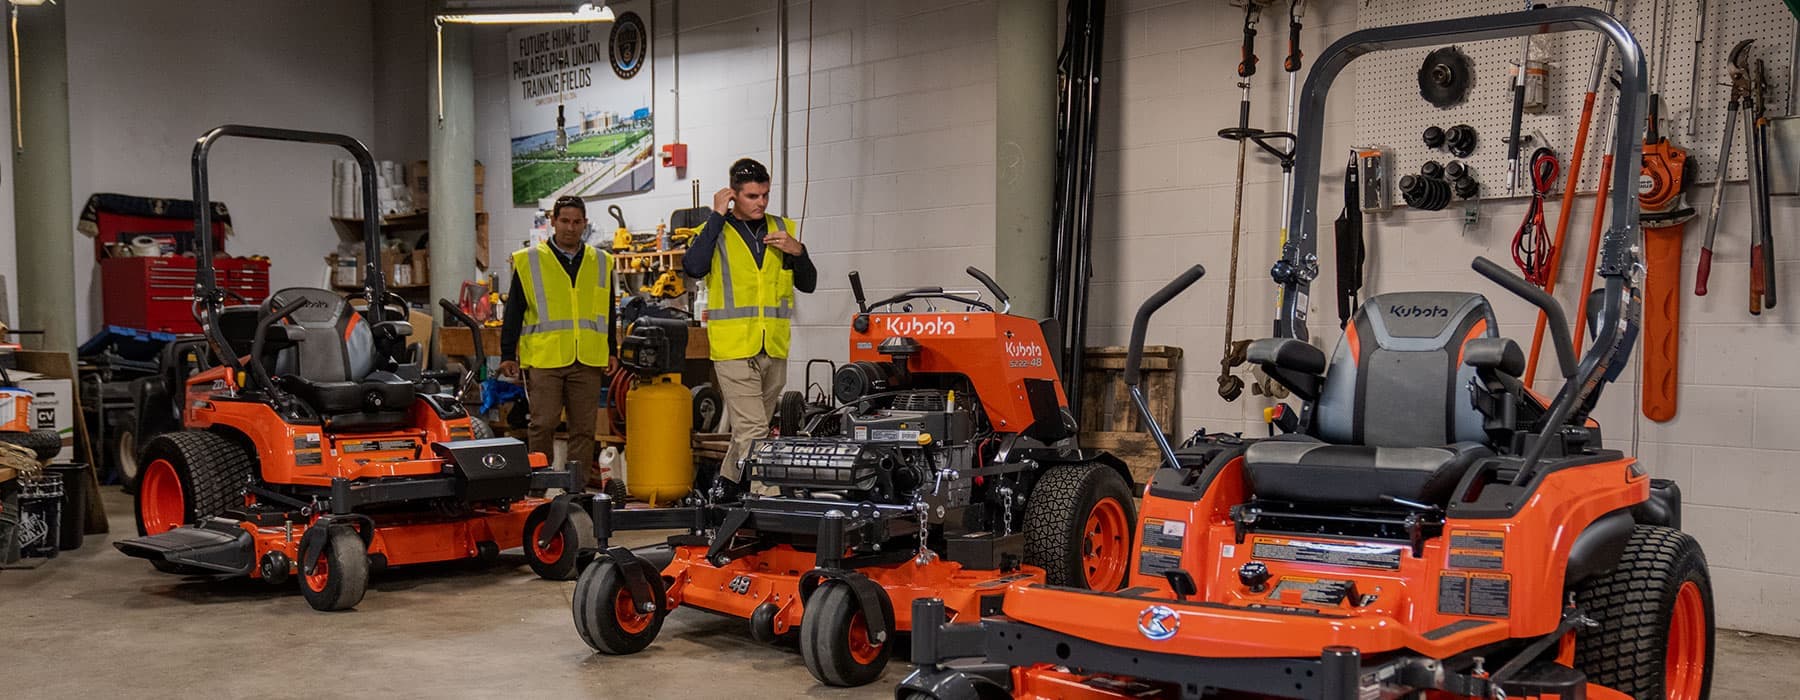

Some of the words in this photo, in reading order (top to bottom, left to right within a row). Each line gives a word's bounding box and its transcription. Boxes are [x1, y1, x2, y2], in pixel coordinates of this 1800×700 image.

[519, 31, 550, 57] FUTURE
[552, 25, 576, 49] HOME
[579, 23, 591, 43] OF
[513, 49, 569, 80] PHILADELPHIA
[572, 42, 600, 66] UNION
[522, 73, 559, 100] TRAINING
[561, 67, 591, 91] FIELDS
[1390, 305, 1448, 317] Kubota
[886, 316, 955, 335] Kubota
[1005, 341, 1041, 357] Kubota
[38, 411, 54, 421] CV
[729, 575, 751, 594] 48
